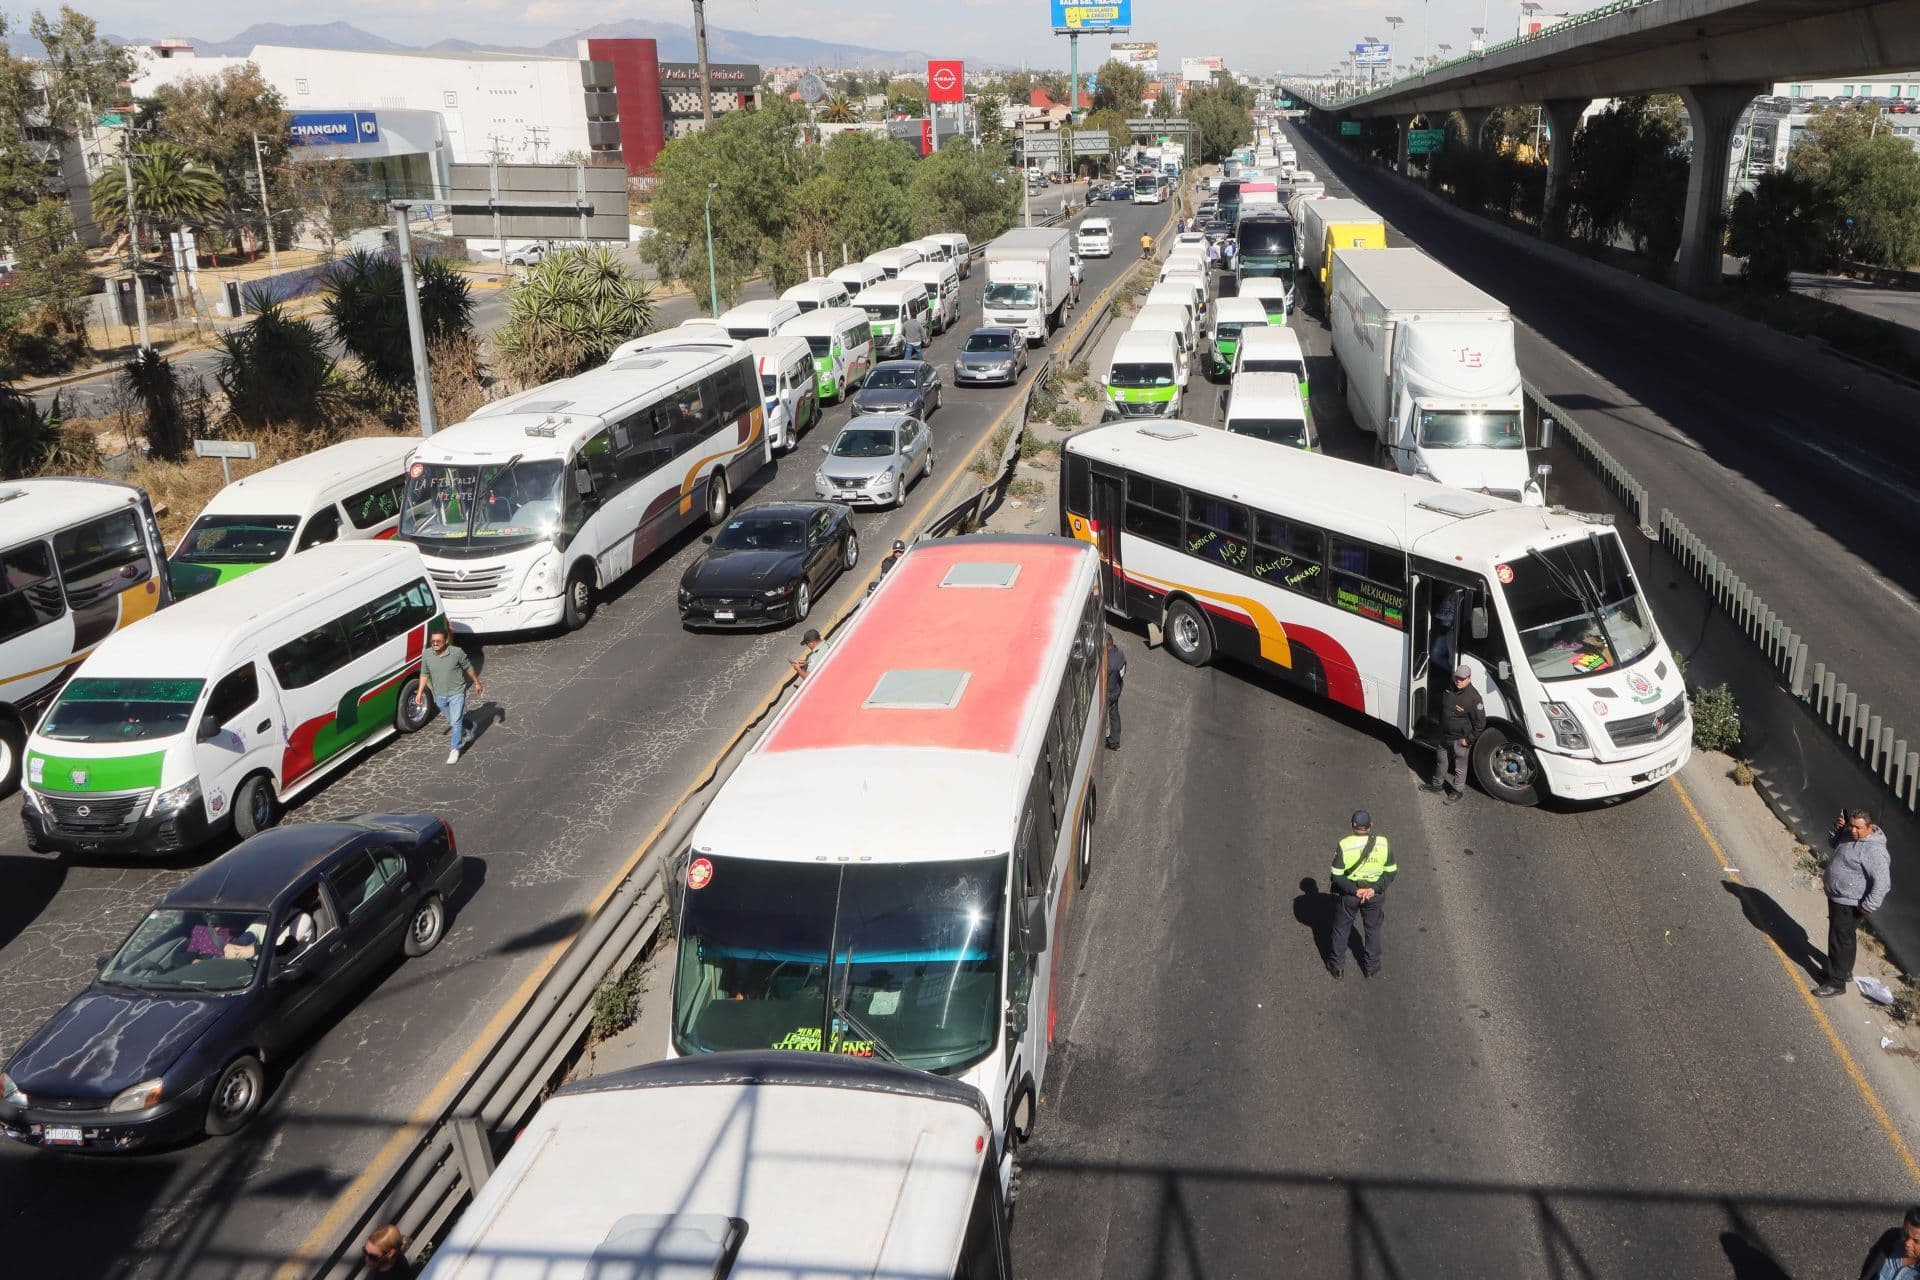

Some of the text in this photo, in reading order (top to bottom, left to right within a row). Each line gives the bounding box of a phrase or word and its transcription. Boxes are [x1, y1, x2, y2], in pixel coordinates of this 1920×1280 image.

[290, 124, 348, 136] CHANGAN
[1219, 543, 1237, 561] NO
[1255, 556, 1293, 576] DELITOS
